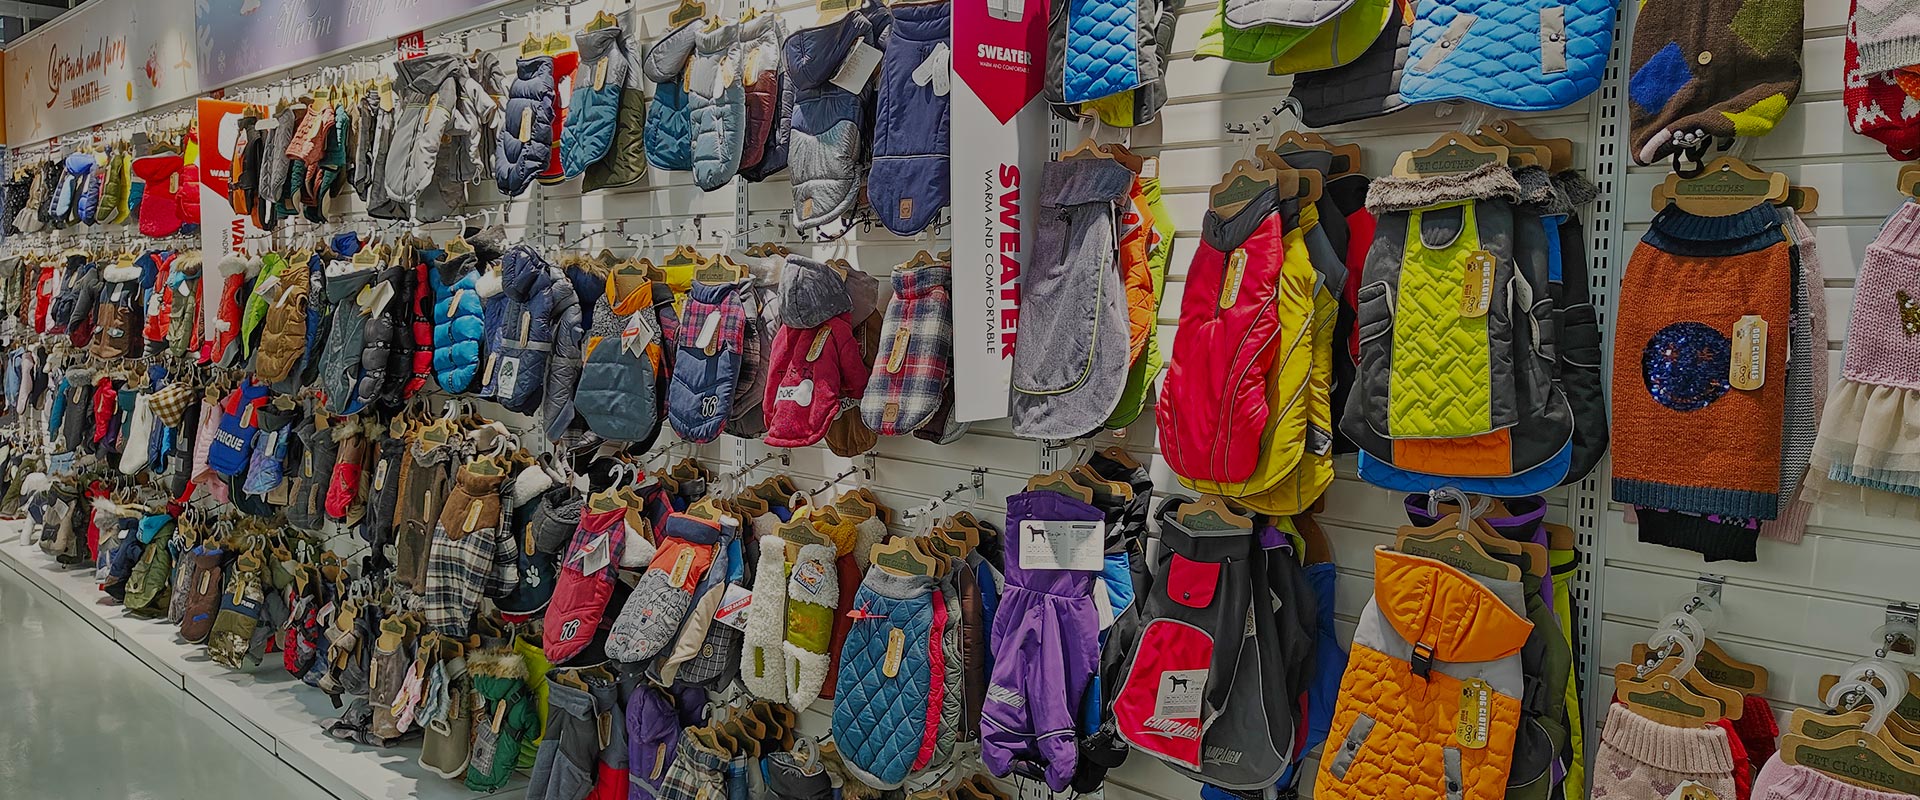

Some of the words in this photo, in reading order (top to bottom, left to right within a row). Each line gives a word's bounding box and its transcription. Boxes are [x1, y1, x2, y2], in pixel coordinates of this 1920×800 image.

[86, 37, 102, 72] and
[104, 35, 126, 77] furry
[977, 43, 1032, 65] SWEATER
[71, 80, 100, 109] WARMTH
[1414, 162, 1430, 171] PET
[1431, 160, 1475, 170] CLOTHES
[984, 169, 993, 213] WARM
[984, 216, 994, 249] AND
[998, 163, 1021, 361] SWEATER
[984, 253, 996, 354] COMFORTABLE
[1752, 327, 1760, 344] DOG
[1751, 345, 1760, 380] CLOTHES
[1411, 545, 1428, 556] PET
[1430, 551, 1473, 571] CLOTHES
[1479, 690, 1487, 706] DOG
[1477, 707, 1487, 742] CLOTHES
[1806, 753, 1828, 767] PET
[1832, 761, 1895, 785] CLOTHES
